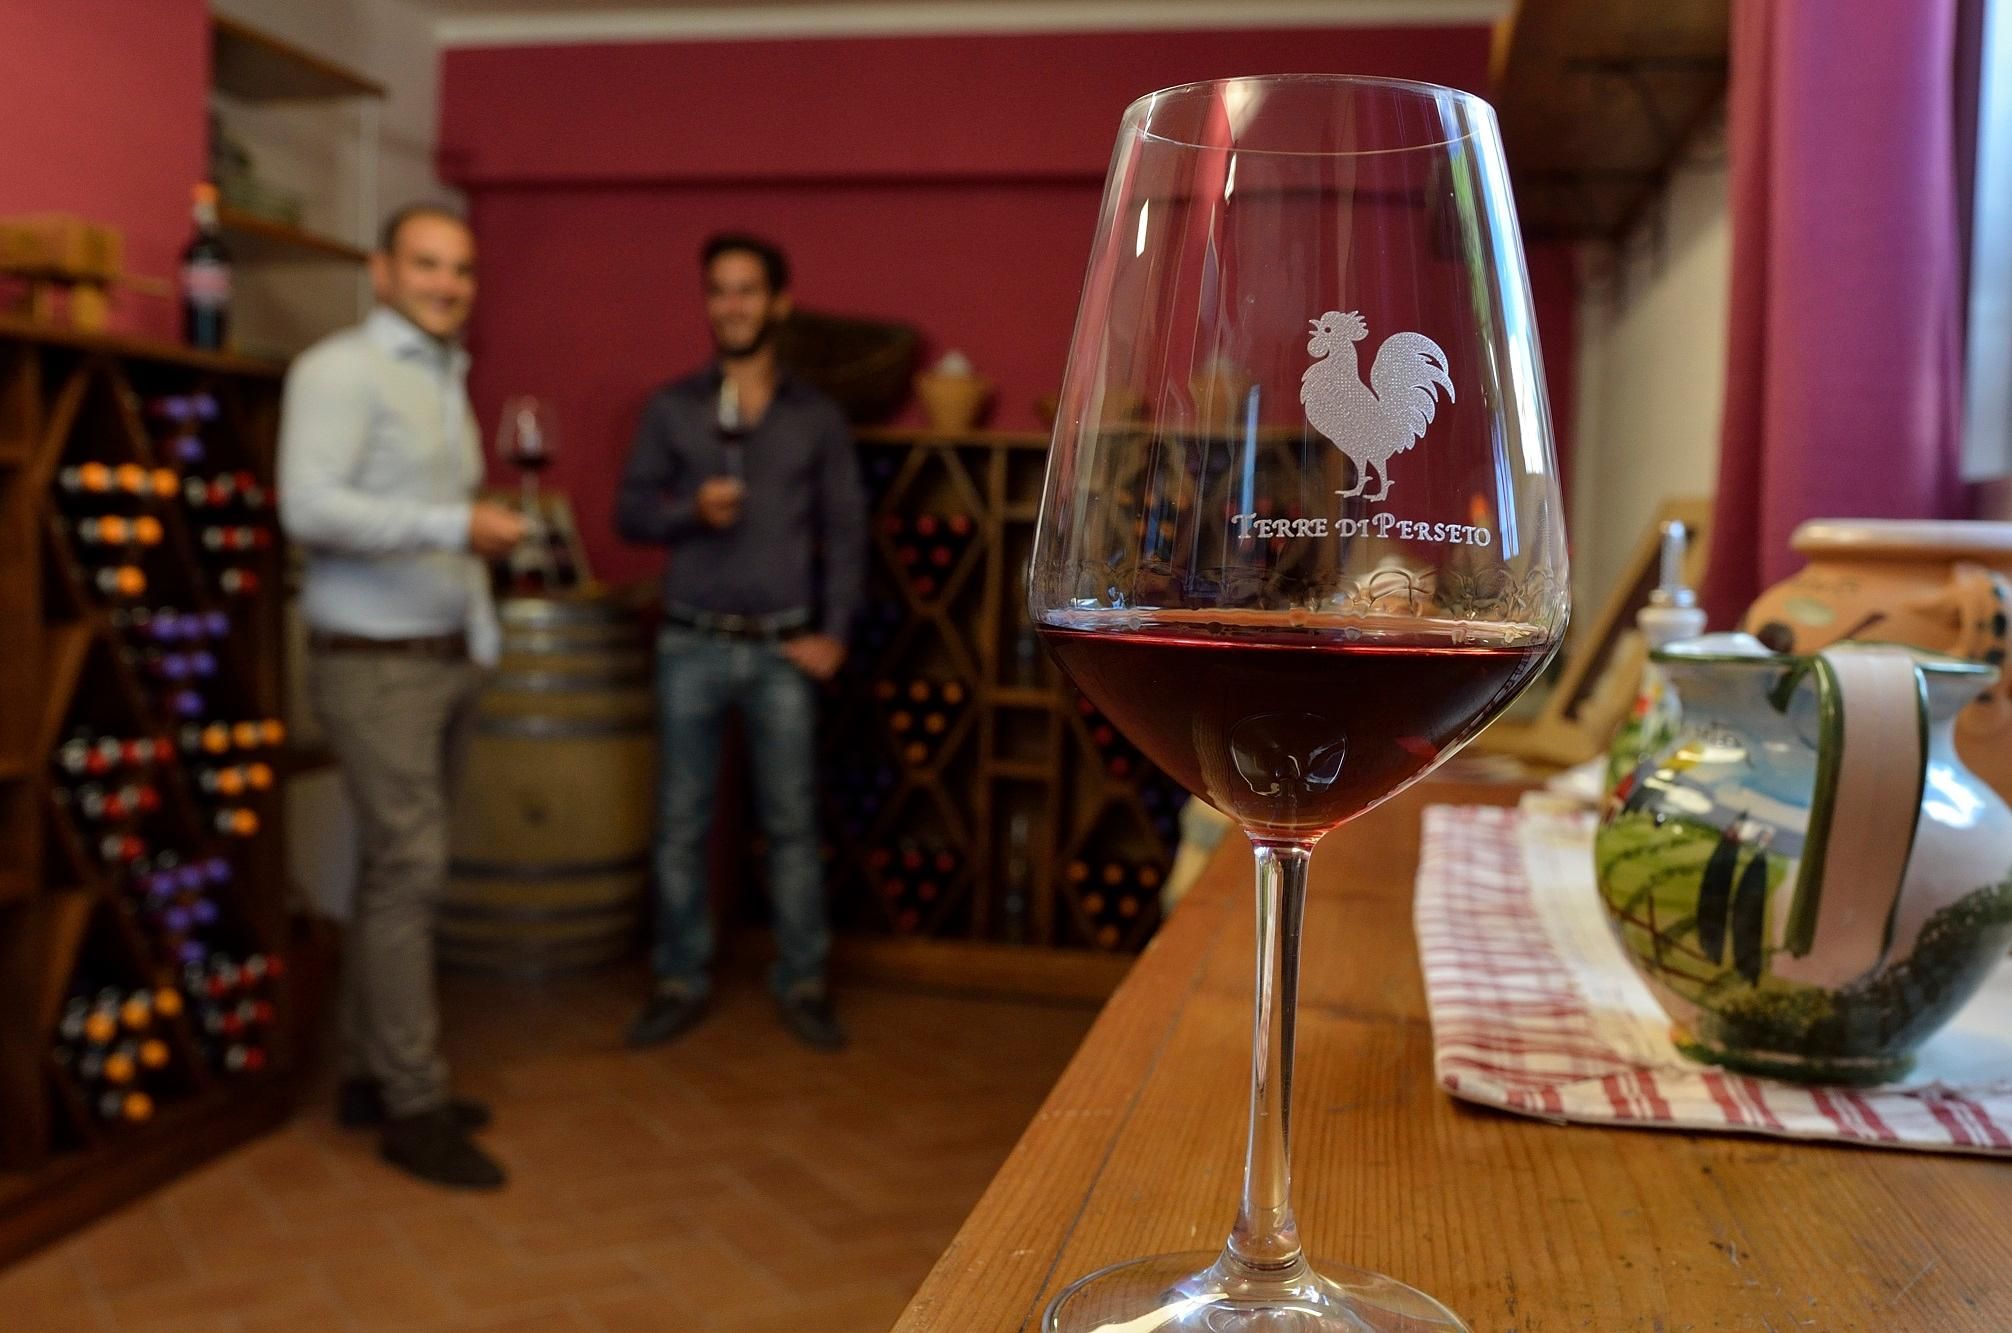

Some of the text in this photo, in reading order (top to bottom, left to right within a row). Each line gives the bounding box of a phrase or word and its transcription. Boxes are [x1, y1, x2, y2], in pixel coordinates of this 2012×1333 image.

[1231, 512, 1491, 547] TERRE DI PERSETO
